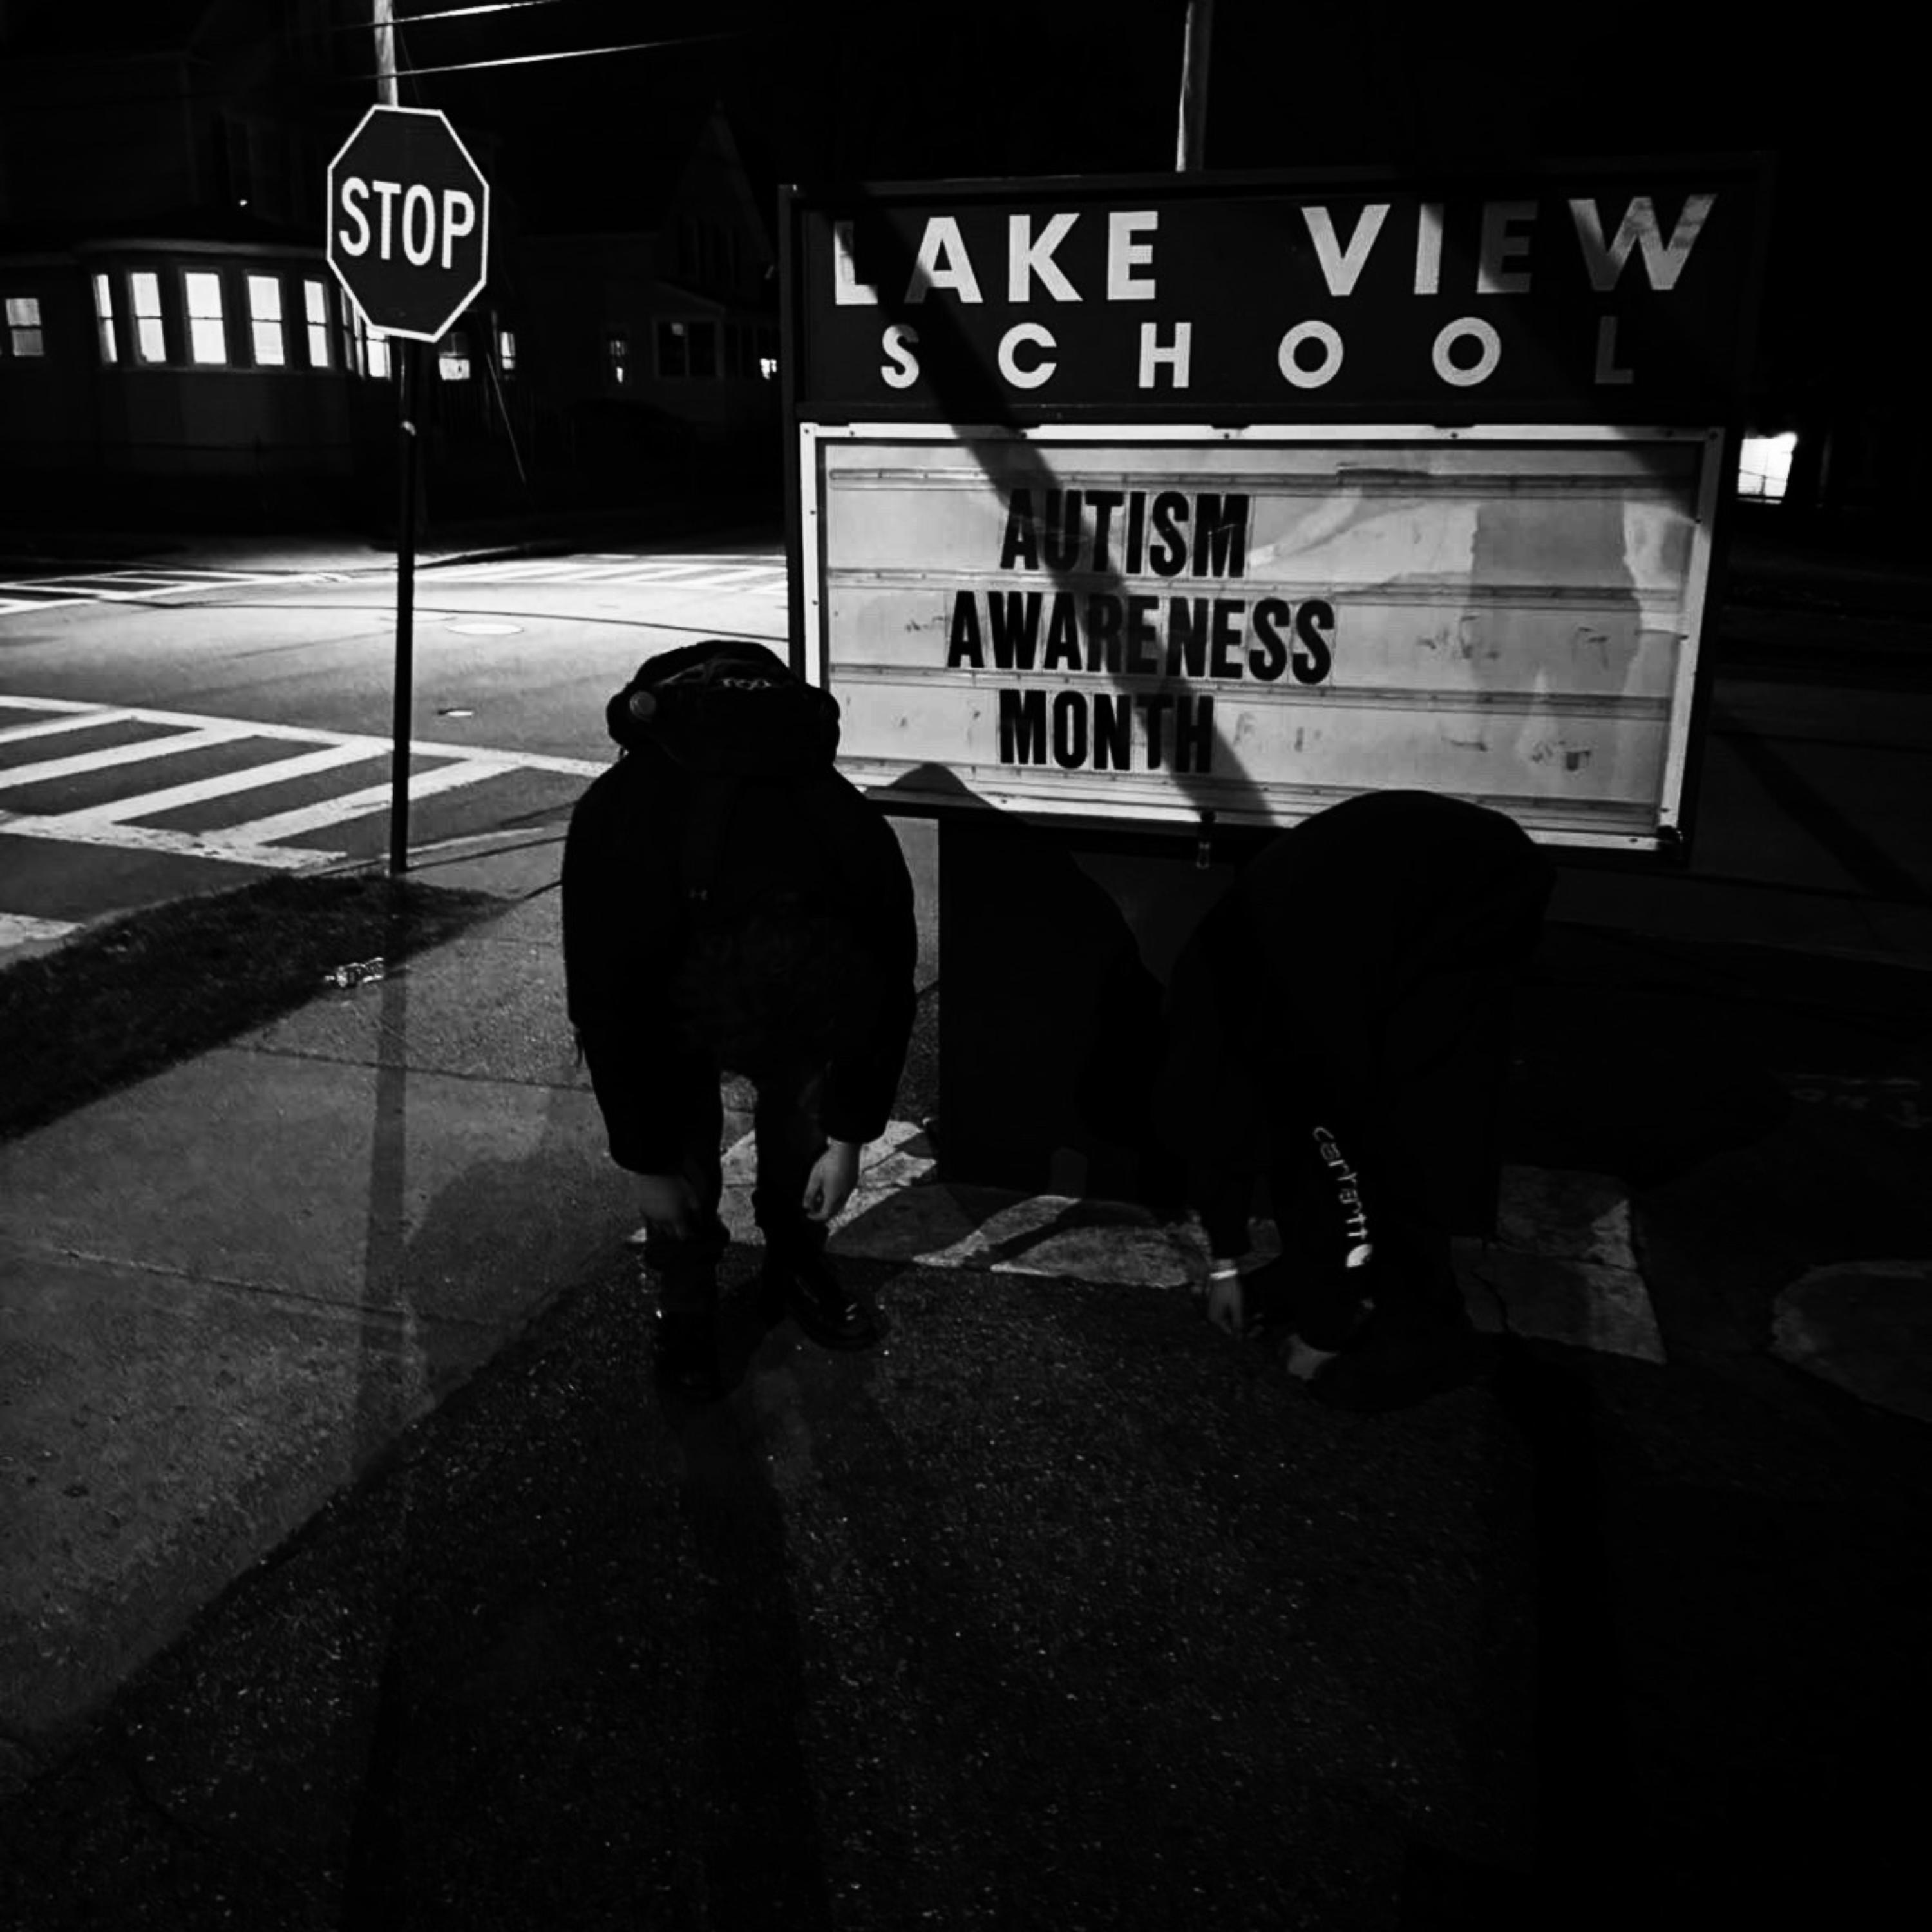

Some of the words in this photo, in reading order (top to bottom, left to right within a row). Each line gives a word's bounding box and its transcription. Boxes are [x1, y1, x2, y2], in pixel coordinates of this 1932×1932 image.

[339, 176, 476, 269] STOP
[833, 209, 1160, 306] LAKE
[1300, 192, 1721, 297] VIEW
[879, 314, 1636, 389] SCHOOL
[999, 488, 1249, 578] AUTISM
[947, 590, 1336, 685] AWARENESS
[999, 689, 1215, 773] MONTH
